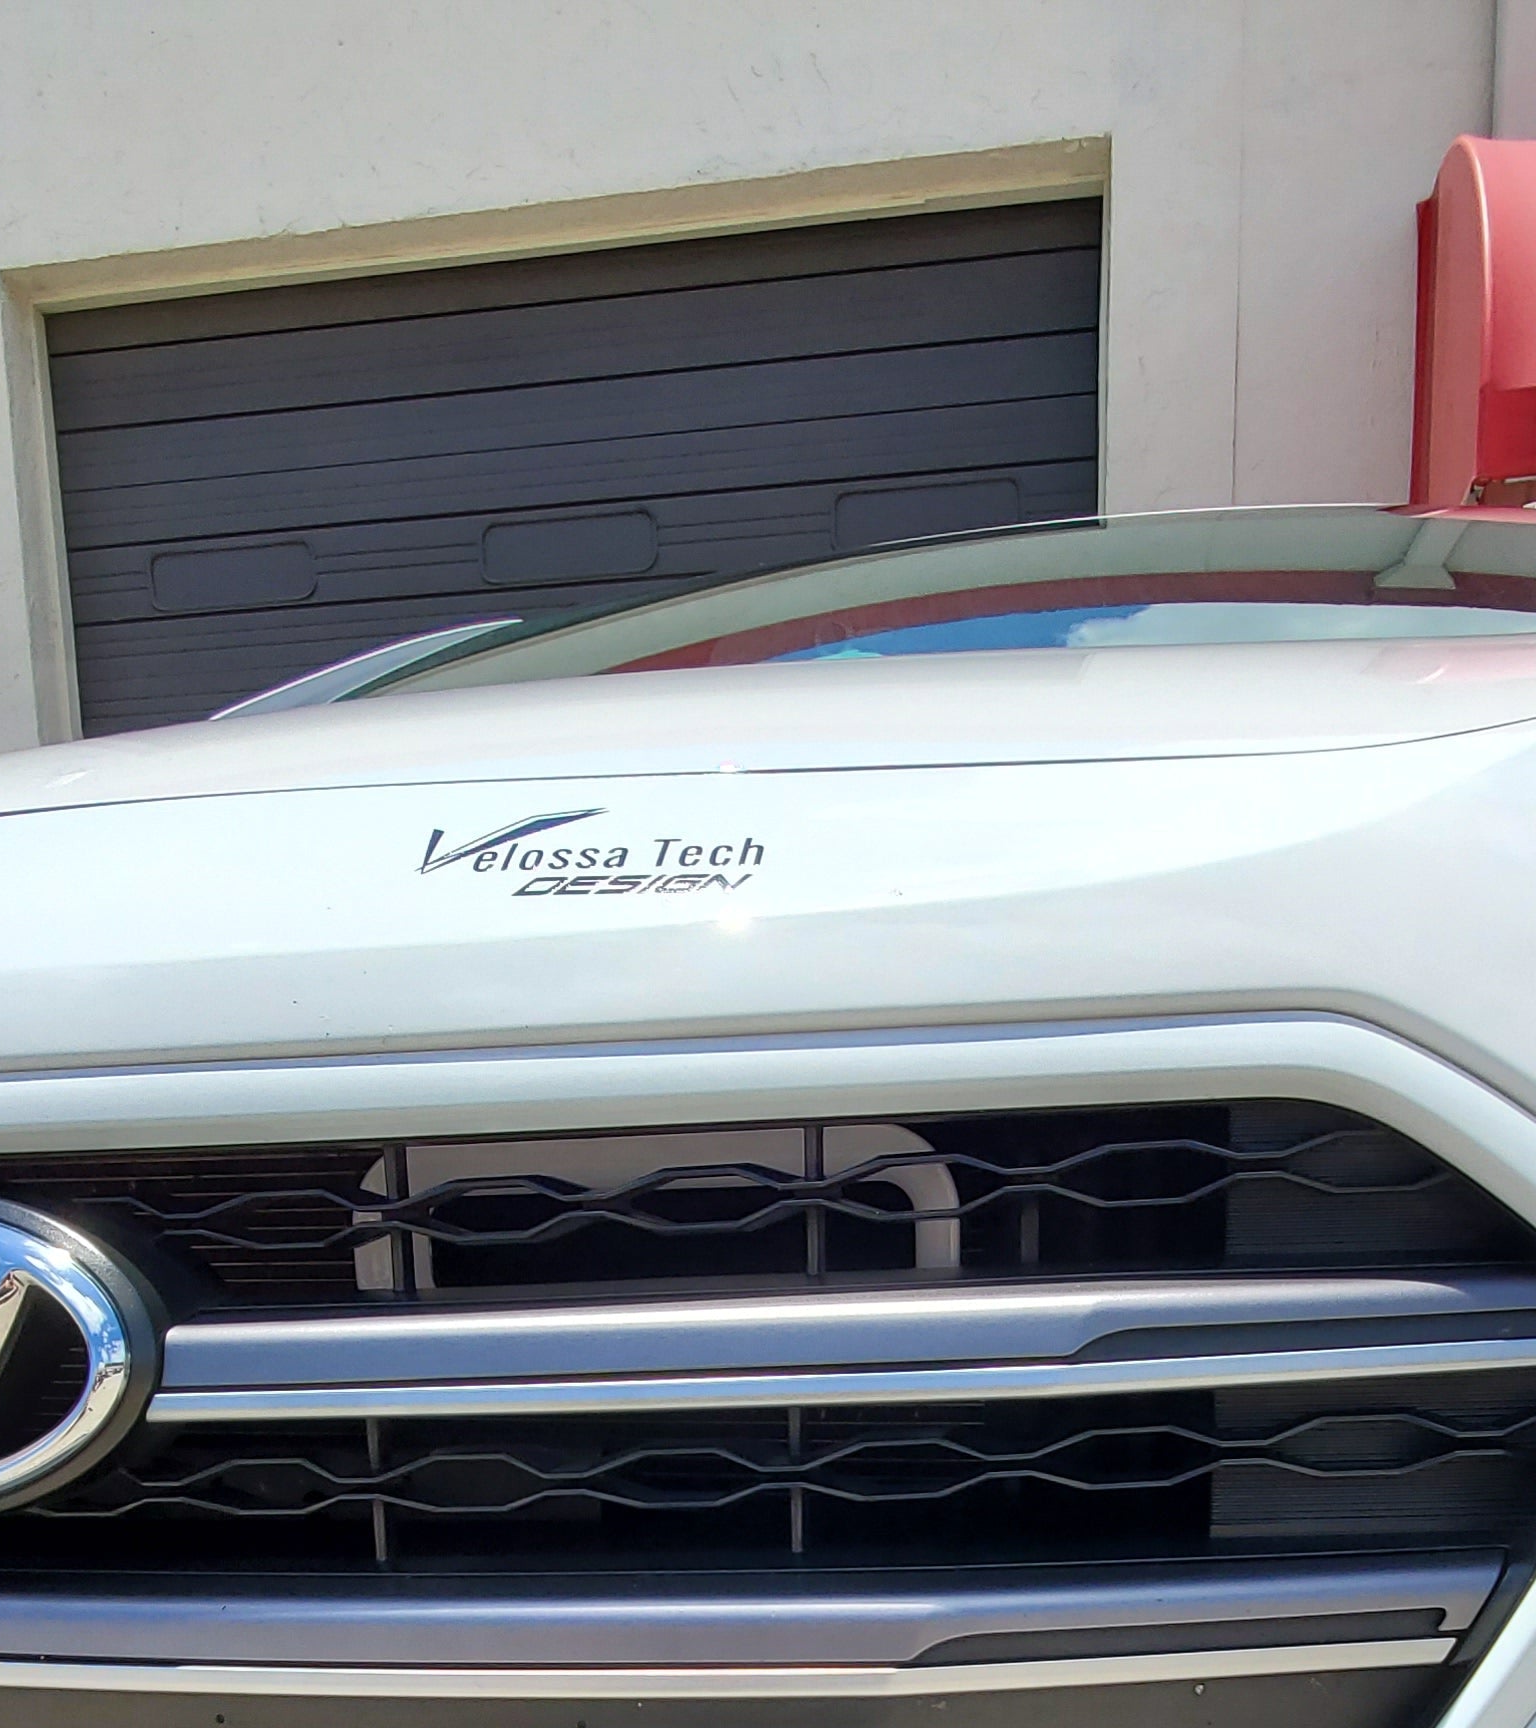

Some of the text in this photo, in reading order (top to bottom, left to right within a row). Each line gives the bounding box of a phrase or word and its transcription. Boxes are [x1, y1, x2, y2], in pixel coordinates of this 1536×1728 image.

[416, 808, 764, 874] Velossa Tech
[511, 873, 753, 897] DESIGN
